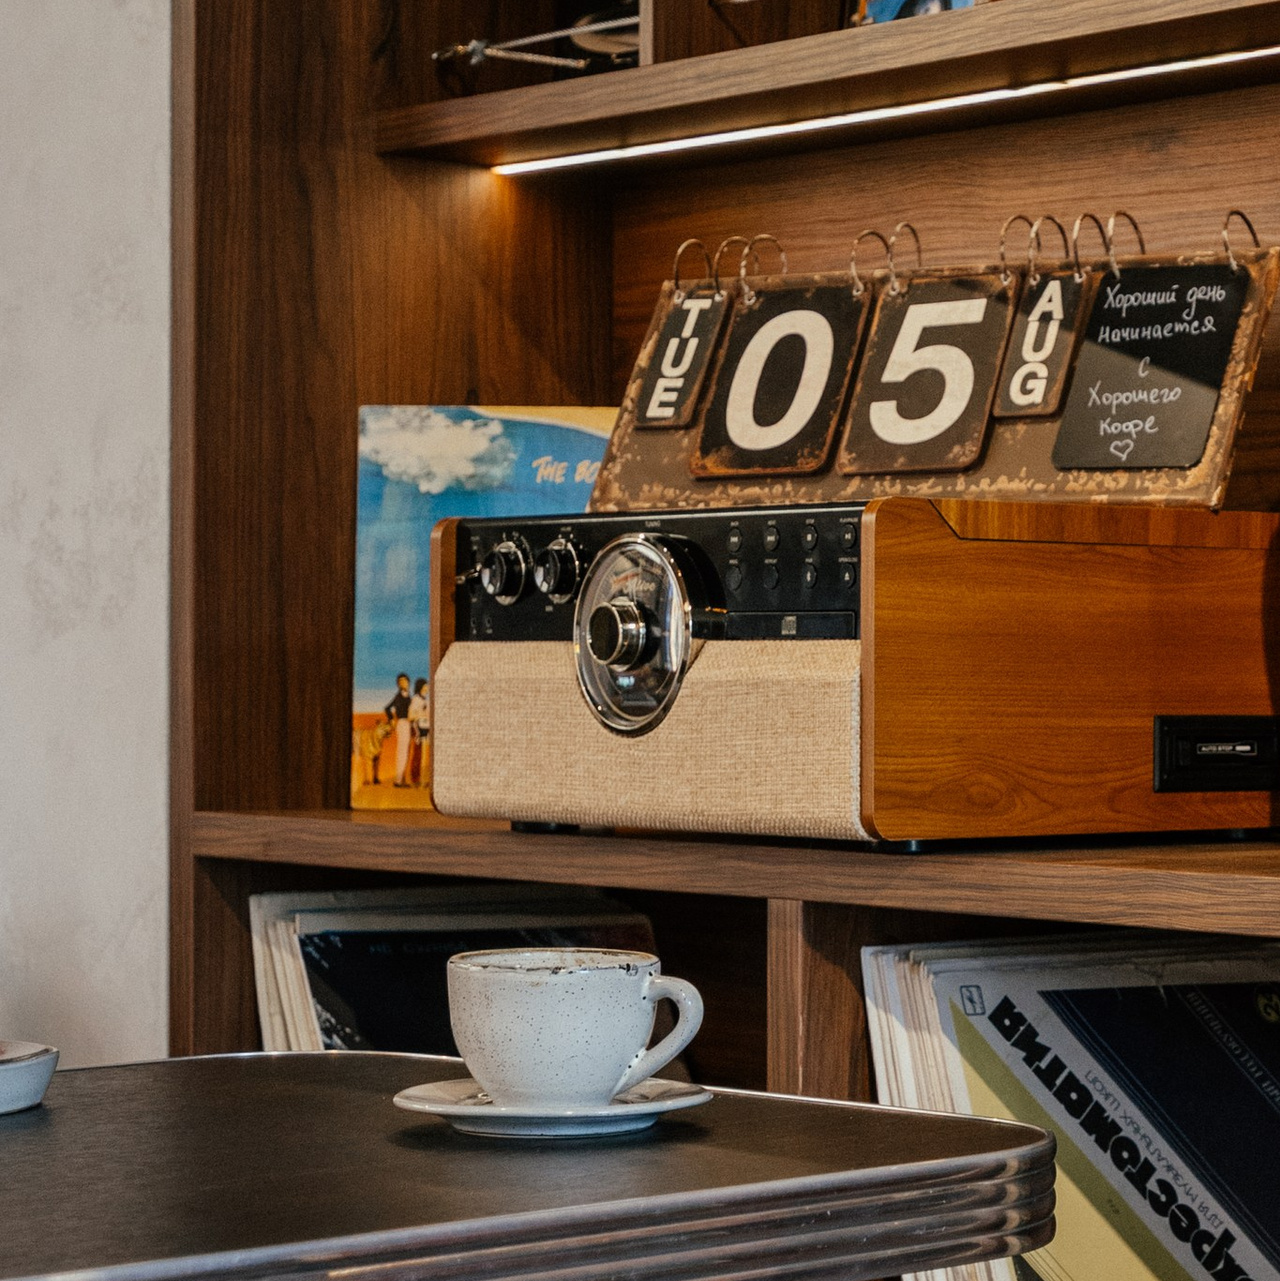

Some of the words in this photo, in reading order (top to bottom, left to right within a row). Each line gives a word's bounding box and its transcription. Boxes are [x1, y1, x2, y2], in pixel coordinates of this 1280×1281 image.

[1104, 283, 1180, 318] Хороший
[1183, 284, 1226, 321] день
[1009, 279, 1065, 407] AUG
[1098, 316, 1217, 343] Начинается
[645, 297, 713, 419] TUE
[1088, 380, 1182, 415] Хорошего
[532, 456, 568, 484] THE
[1084, 1070, 1122, 1112] ШКОЛ
[1119, 1108, 1200, 1205] МУЗЫКАЛЬНЫХ
[1197, 1201, 1225, 1231] ДЛЯ
